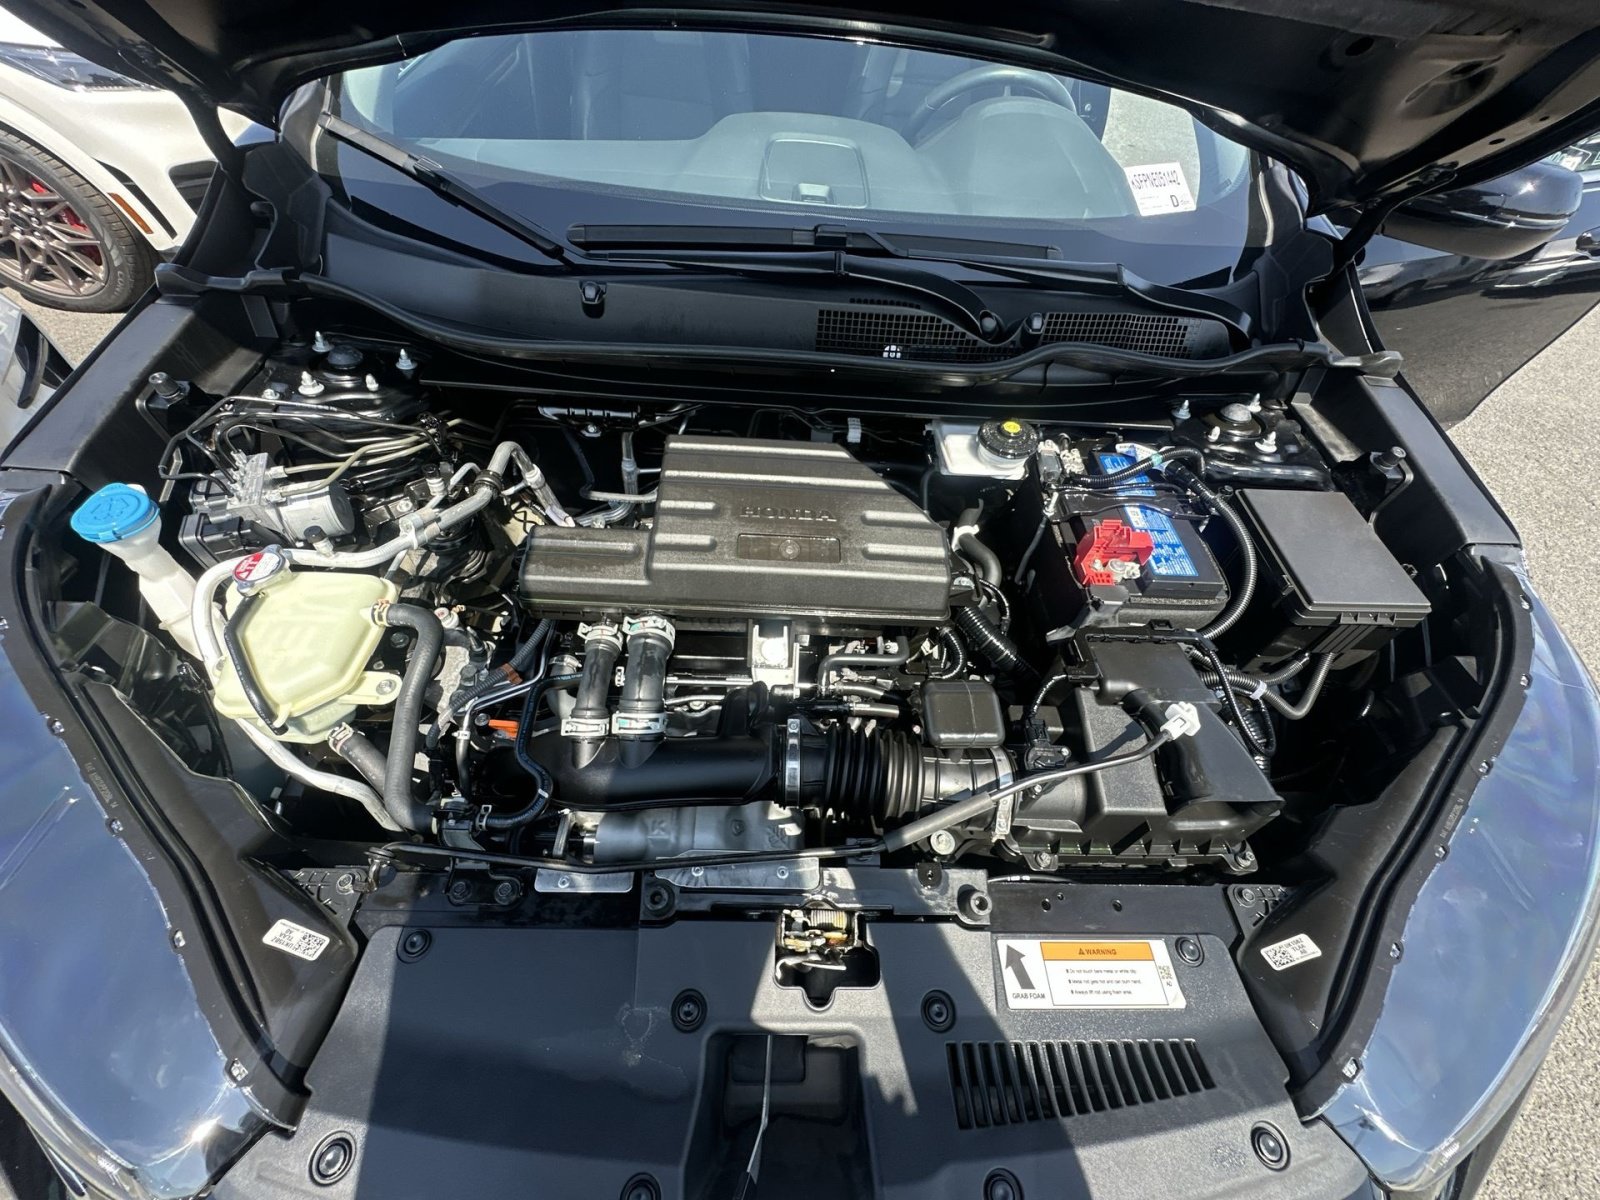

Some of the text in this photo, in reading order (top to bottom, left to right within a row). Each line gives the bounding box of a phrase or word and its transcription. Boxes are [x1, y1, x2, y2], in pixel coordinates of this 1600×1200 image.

[1170, 194, 1180, 208] D
[740, 506, 837, 522] HONDA
[1085, 948, 1117, 956] WARNING
[1012, 992, 1046, 1000] GRAB FOAM
